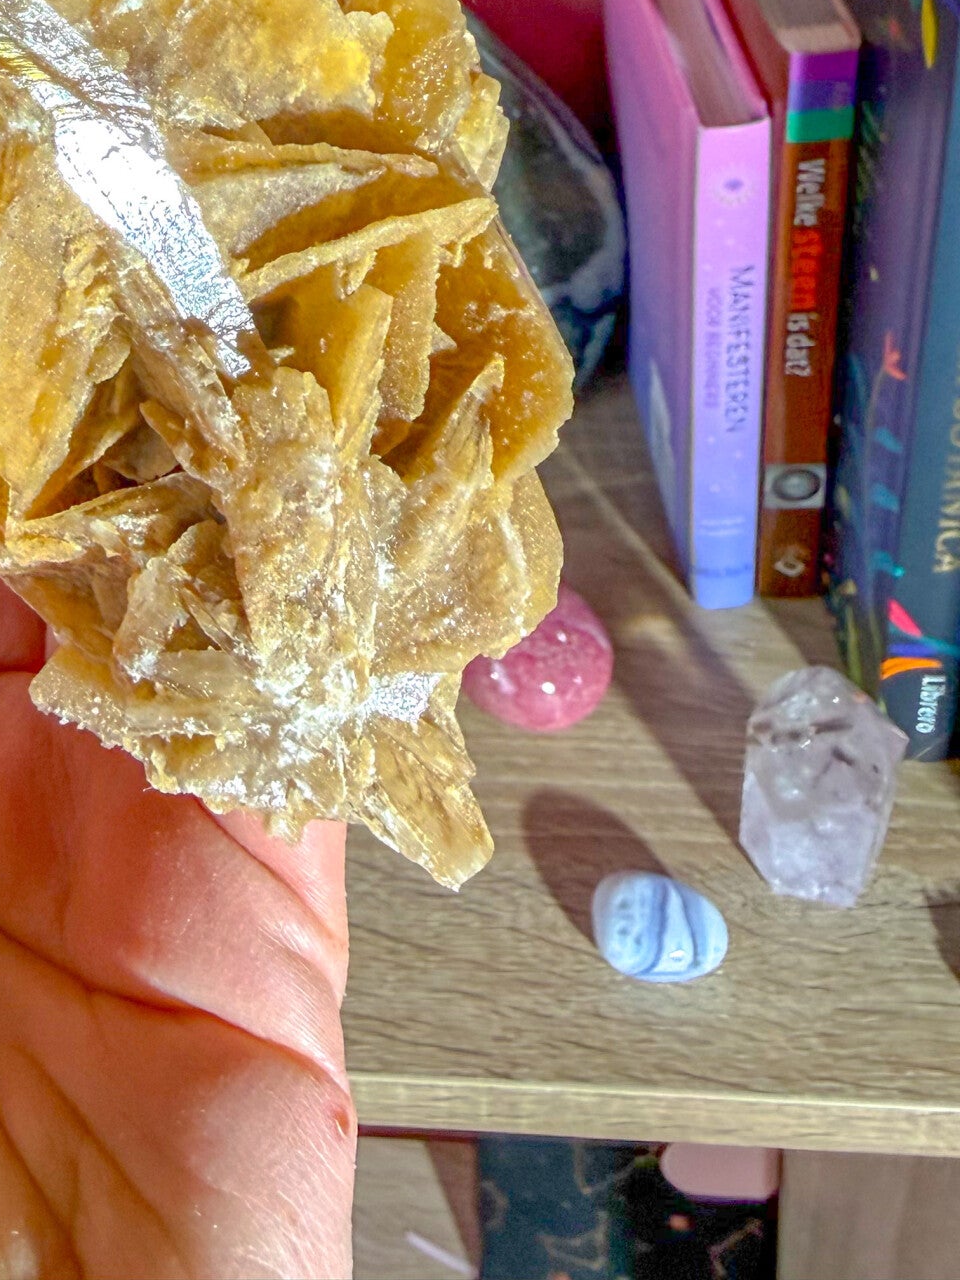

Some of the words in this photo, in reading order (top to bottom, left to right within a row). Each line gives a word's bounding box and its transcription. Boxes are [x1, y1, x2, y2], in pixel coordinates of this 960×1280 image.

[793, 158, 826, 227] Welke
[791, 229, 824, 310] steen
[725, 264, 756, 433] MANIFESTEREN
[787, 312, 820, 332] is
[784, 333, 817, 378] dat?
[915, 674, 947, 734] Librero
